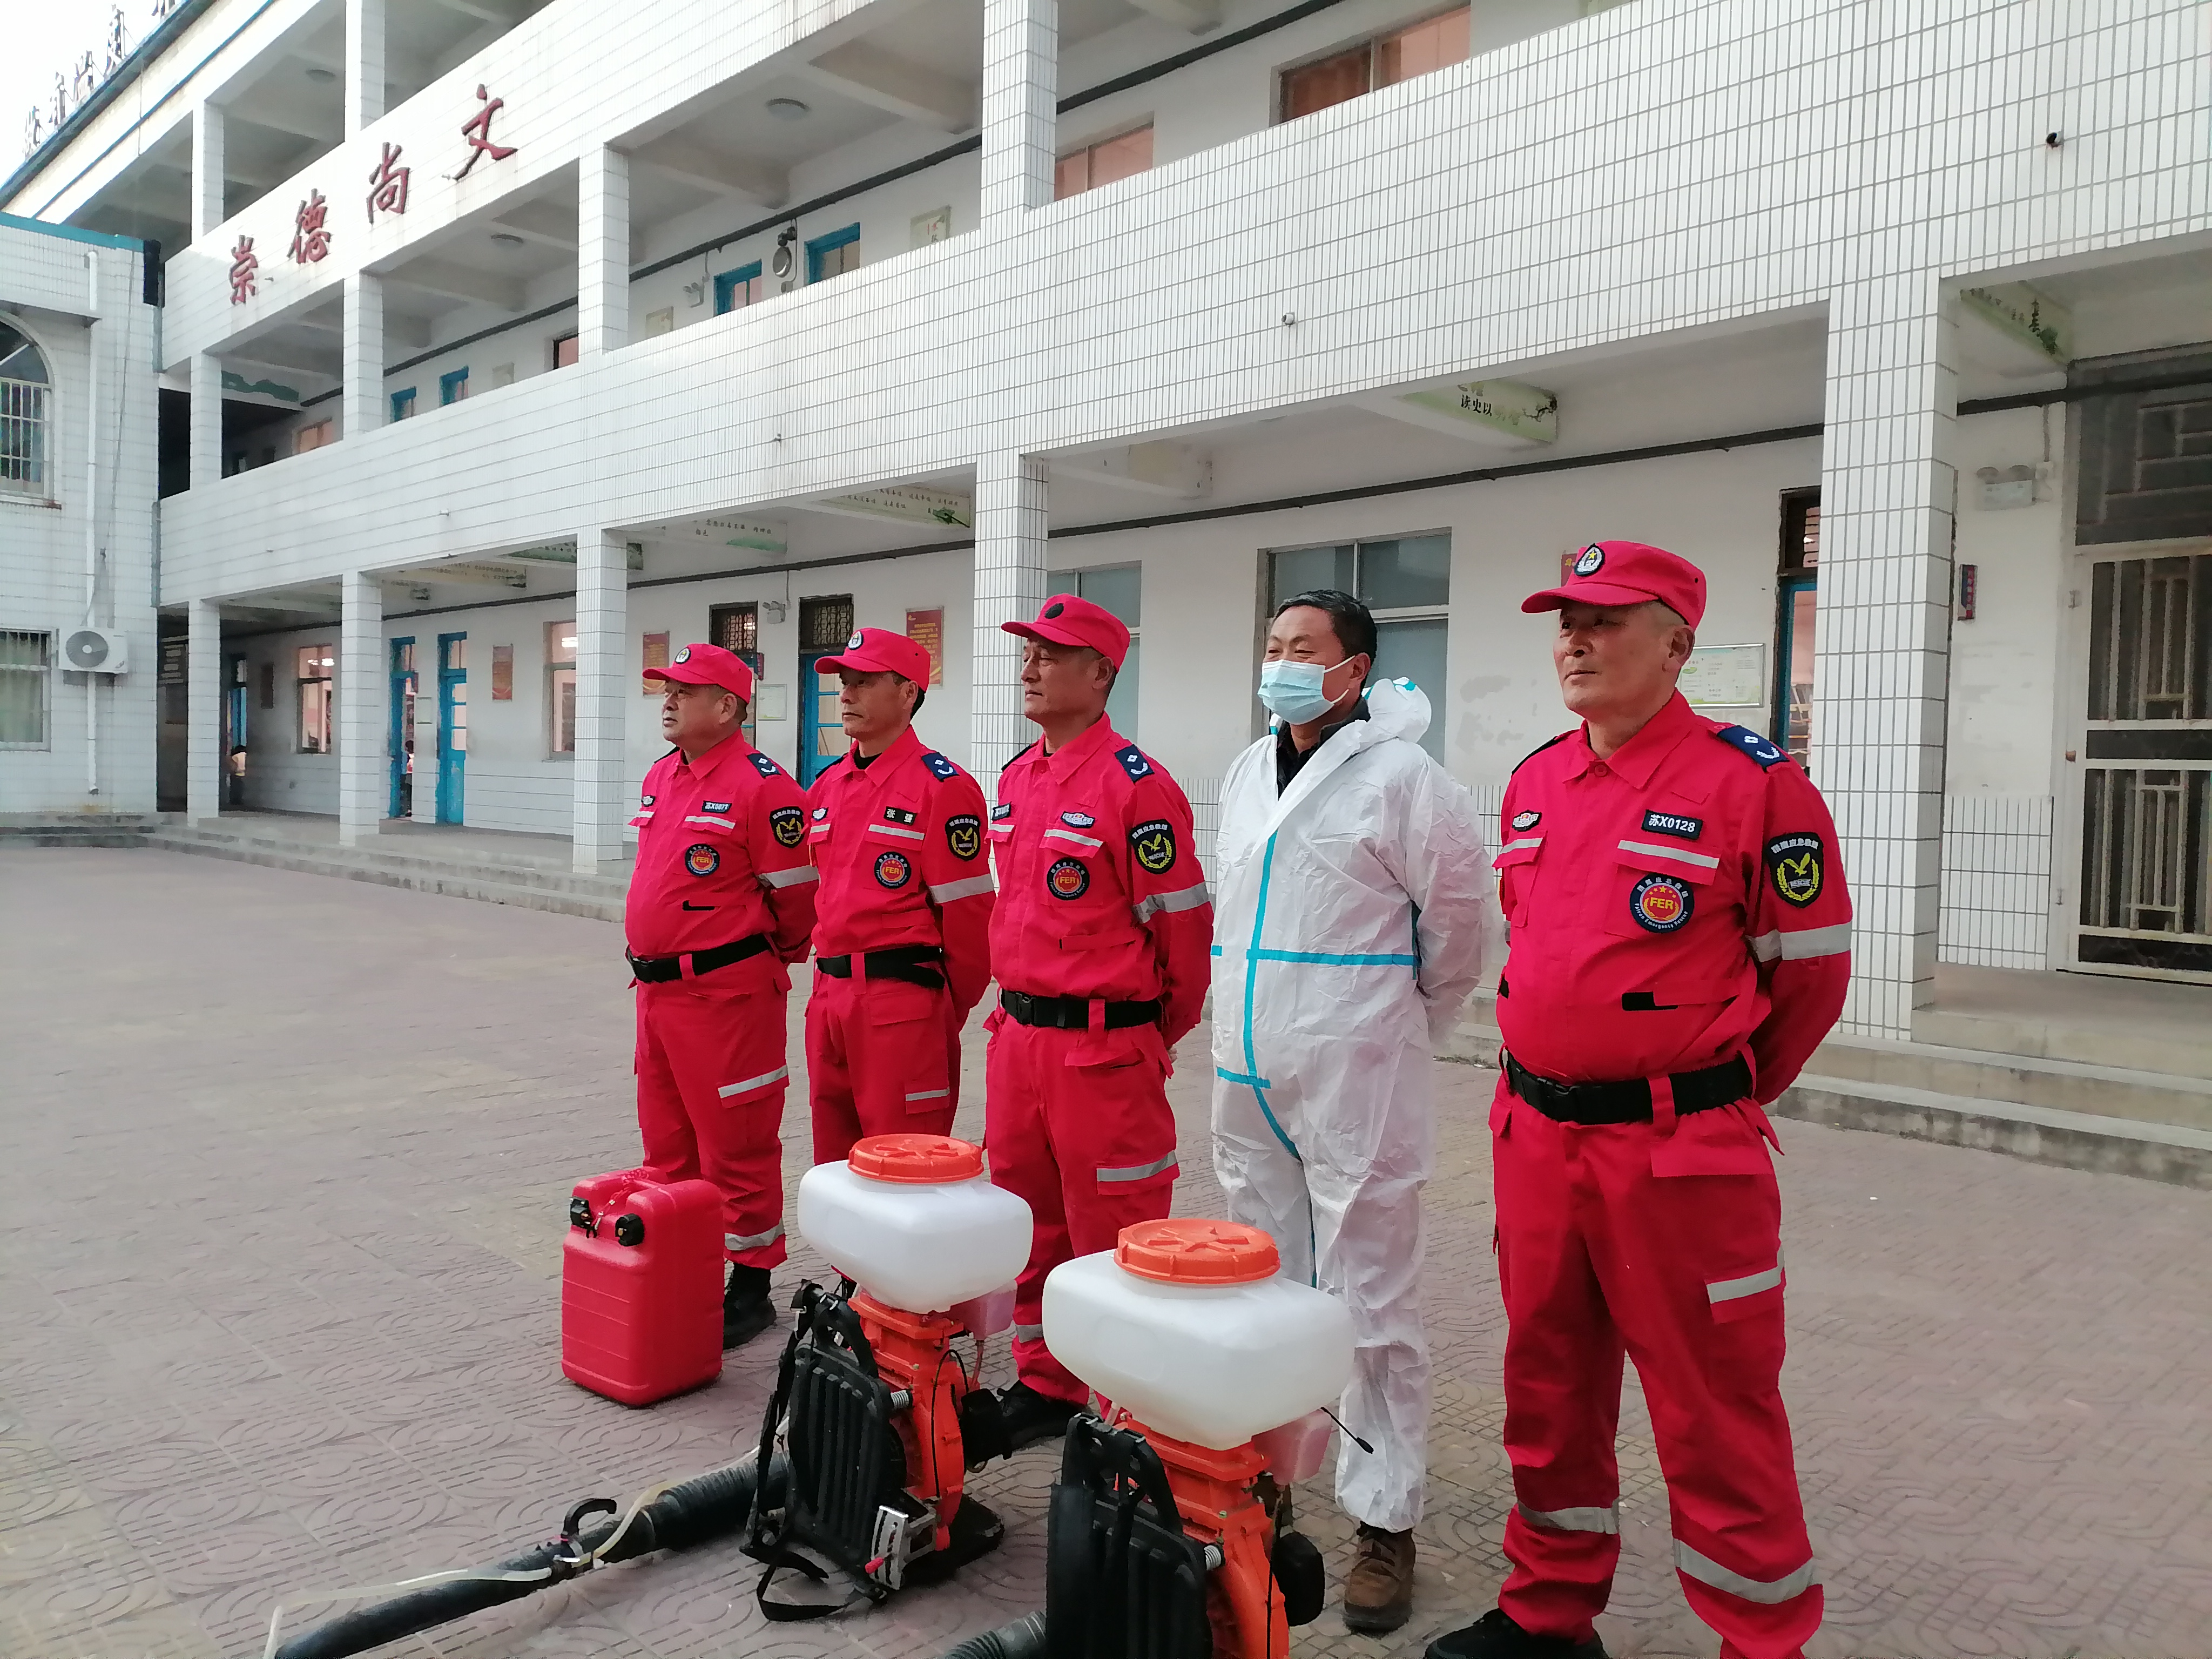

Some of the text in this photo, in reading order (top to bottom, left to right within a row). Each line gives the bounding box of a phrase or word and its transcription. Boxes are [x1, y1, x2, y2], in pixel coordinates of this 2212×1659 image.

[227, 84, 517, 305] 崇德尚文
[1648, 814, 1696, 833] 苏X0128
[1650, 897, 1674, 910] FER
